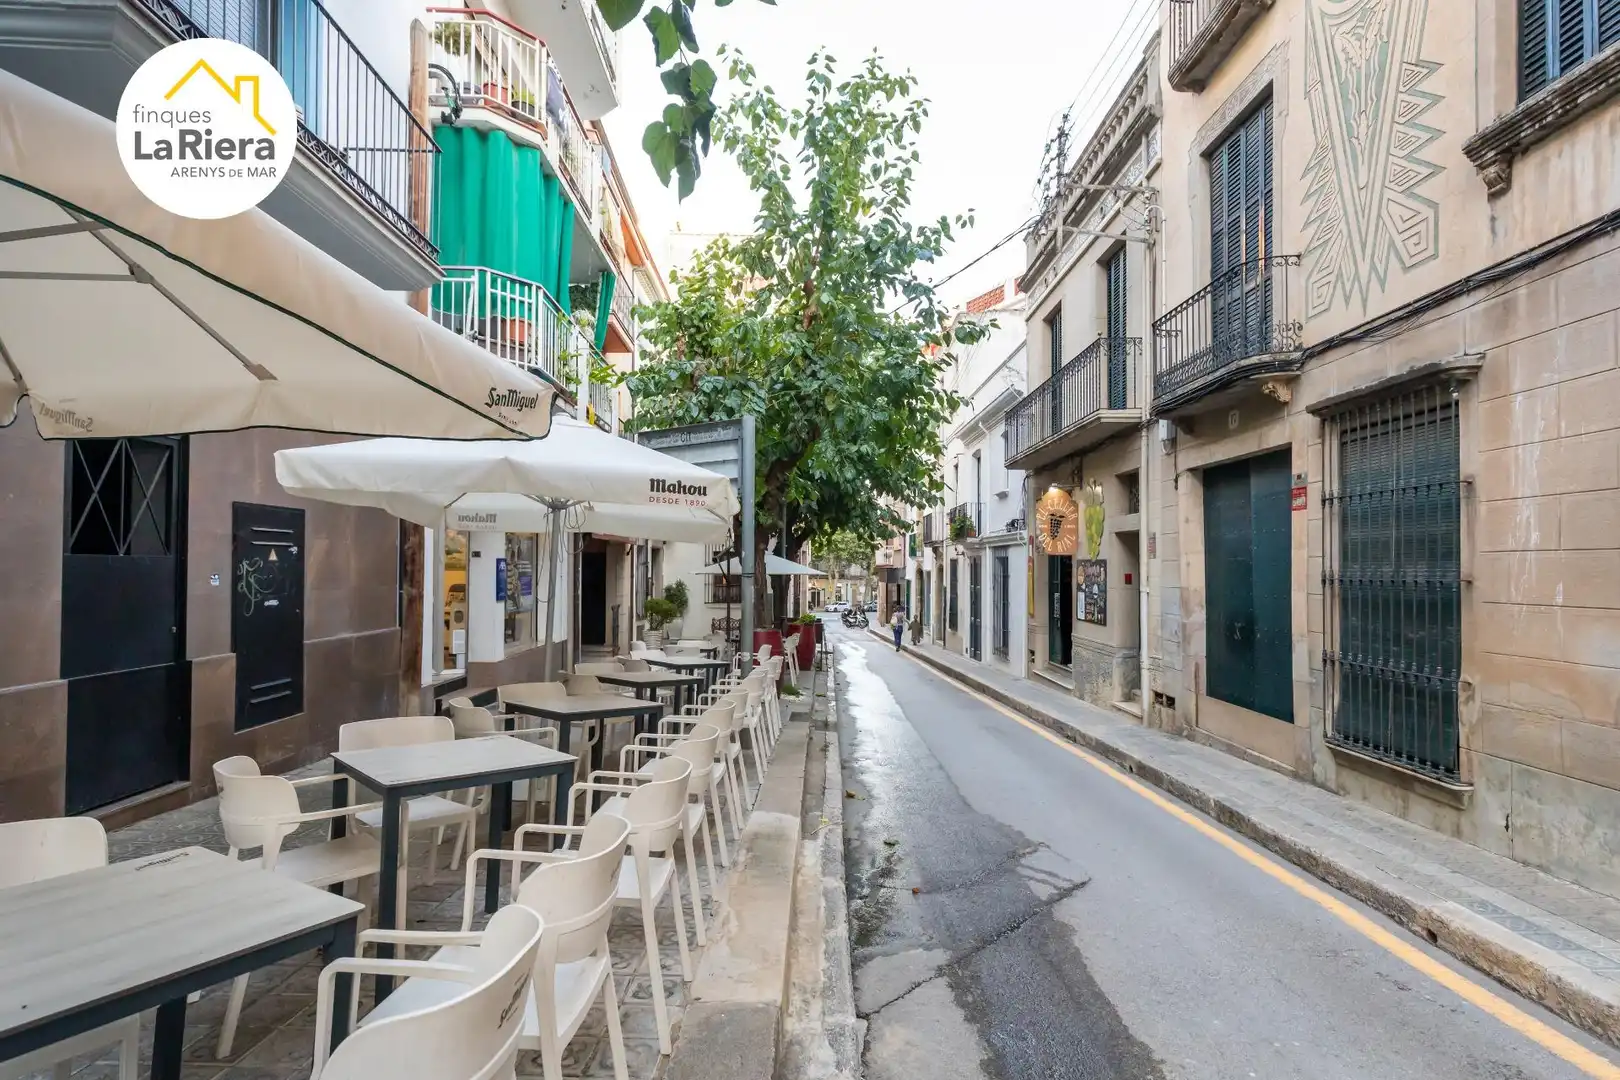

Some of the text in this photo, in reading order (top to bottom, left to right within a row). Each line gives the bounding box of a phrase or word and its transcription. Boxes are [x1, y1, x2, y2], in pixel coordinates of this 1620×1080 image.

[649, 478, 707, 496] Mahou
[649, 496, 706, 507] DESDE 1890
[1036, 499, 1078, 521] EL CELLER
[1038, 533, 1076, 552] DEL RIAL
